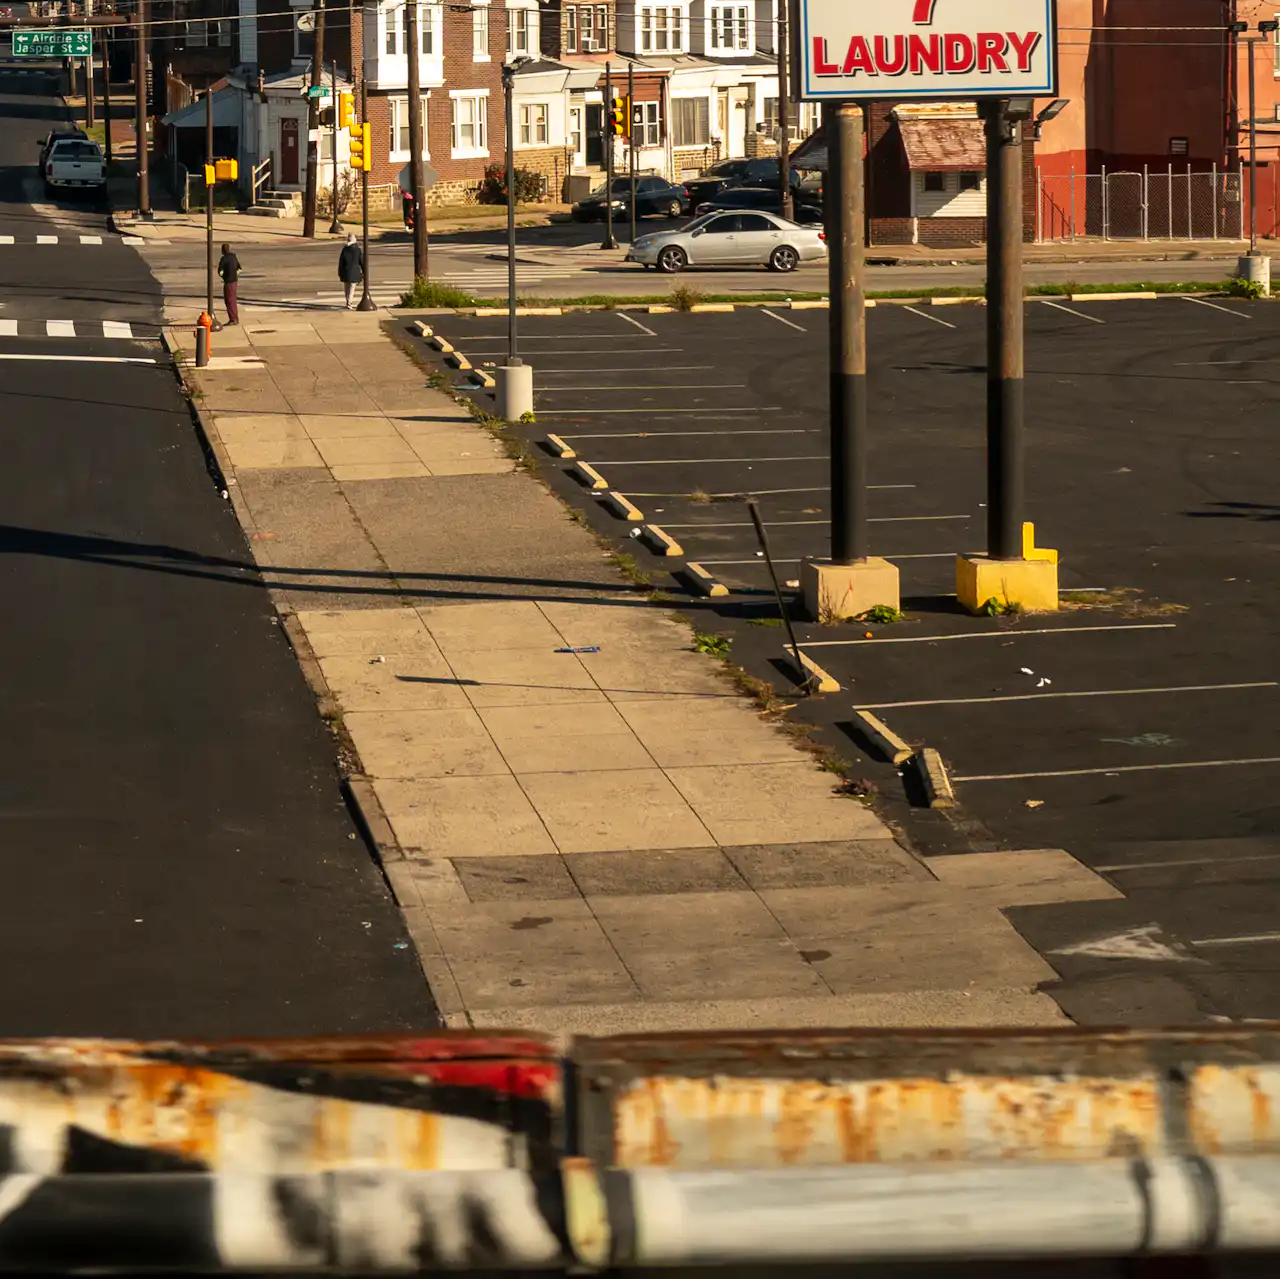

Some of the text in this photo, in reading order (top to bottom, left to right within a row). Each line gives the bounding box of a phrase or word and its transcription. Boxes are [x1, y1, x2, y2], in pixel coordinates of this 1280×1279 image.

[32, 34, 88, 43] Airdrie St
[17, 44, 72, 54] Jasper St
[813, 31, 1042, 77] LAUNDRY
